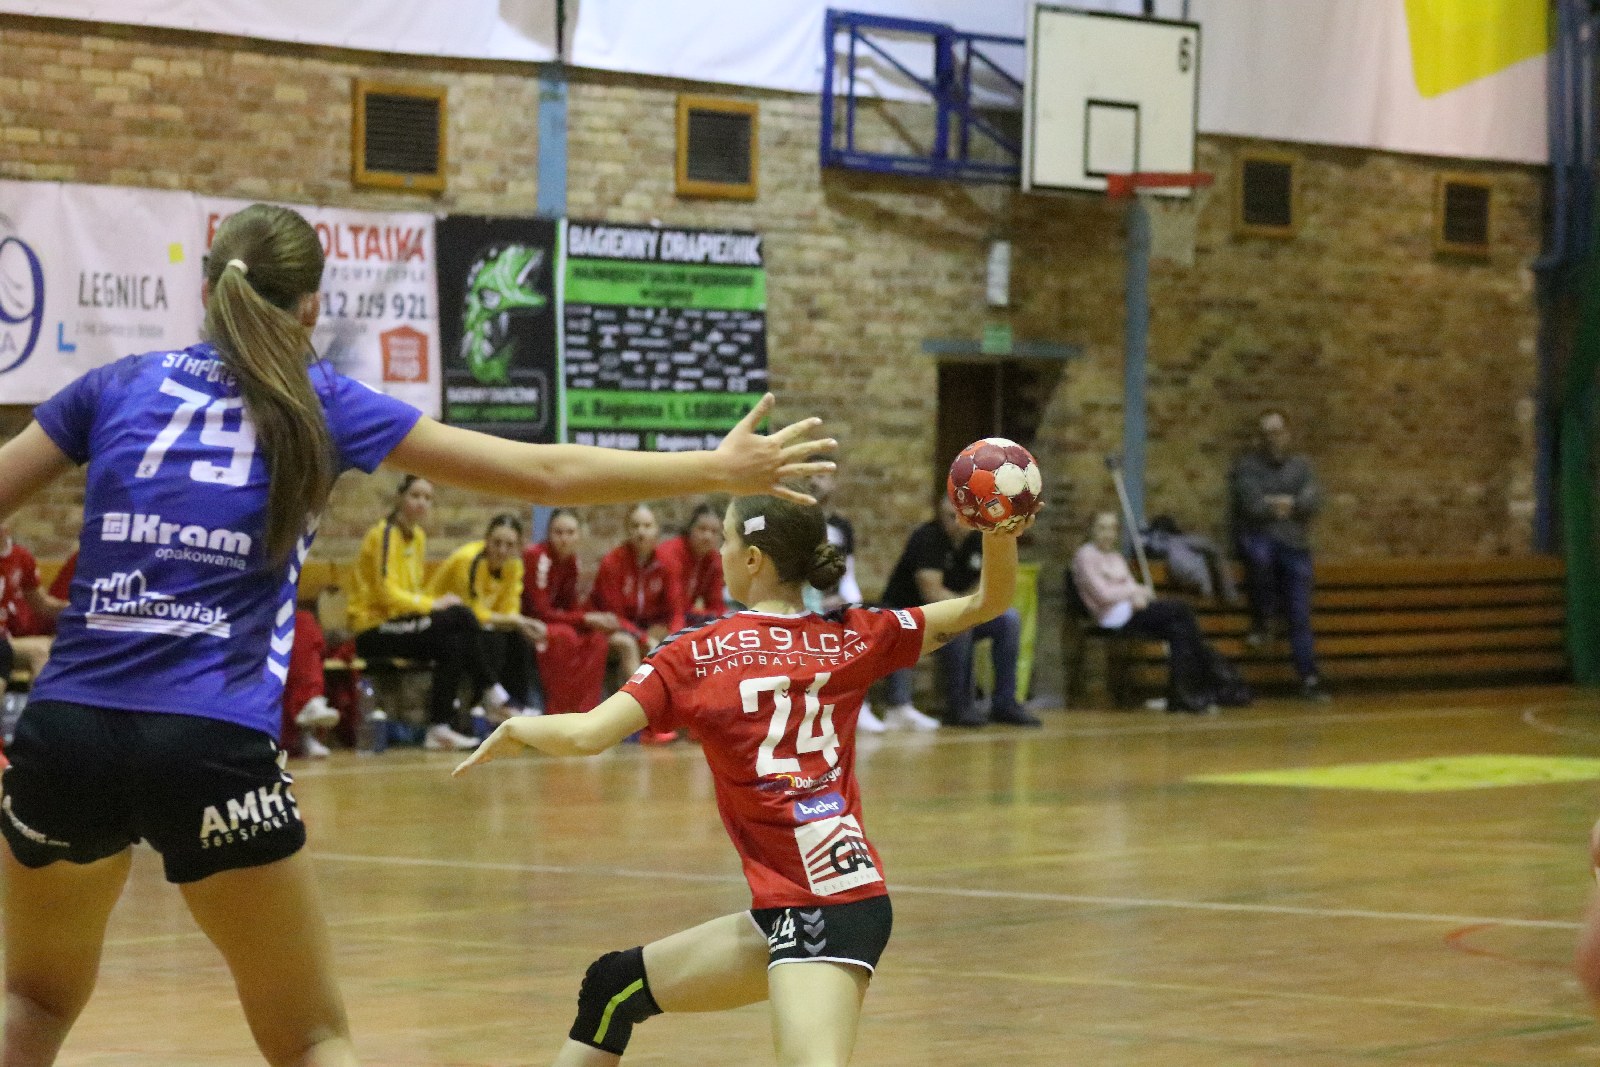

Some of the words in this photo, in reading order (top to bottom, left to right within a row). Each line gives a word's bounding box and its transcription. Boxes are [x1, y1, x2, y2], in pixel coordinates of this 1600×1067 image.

[78, 271, 168, 311] LEGNICA
[323, 292, 348, 318] 12
[391, 293, 428, 320] 921
[135, 377, 256, 487] 79
[130, 513, 252, 556] Kram
[155, 548, 247, 571] opakowania
[691, 629, 761, 661] UKS
[769, 626, 793, 650] 9
[696, 655, 806, 678] HANDBALL
[816, 641, 868, 667] TEAM
[739, 671, 840, 777] 24
[239, 810, 289, 841] SPORT
